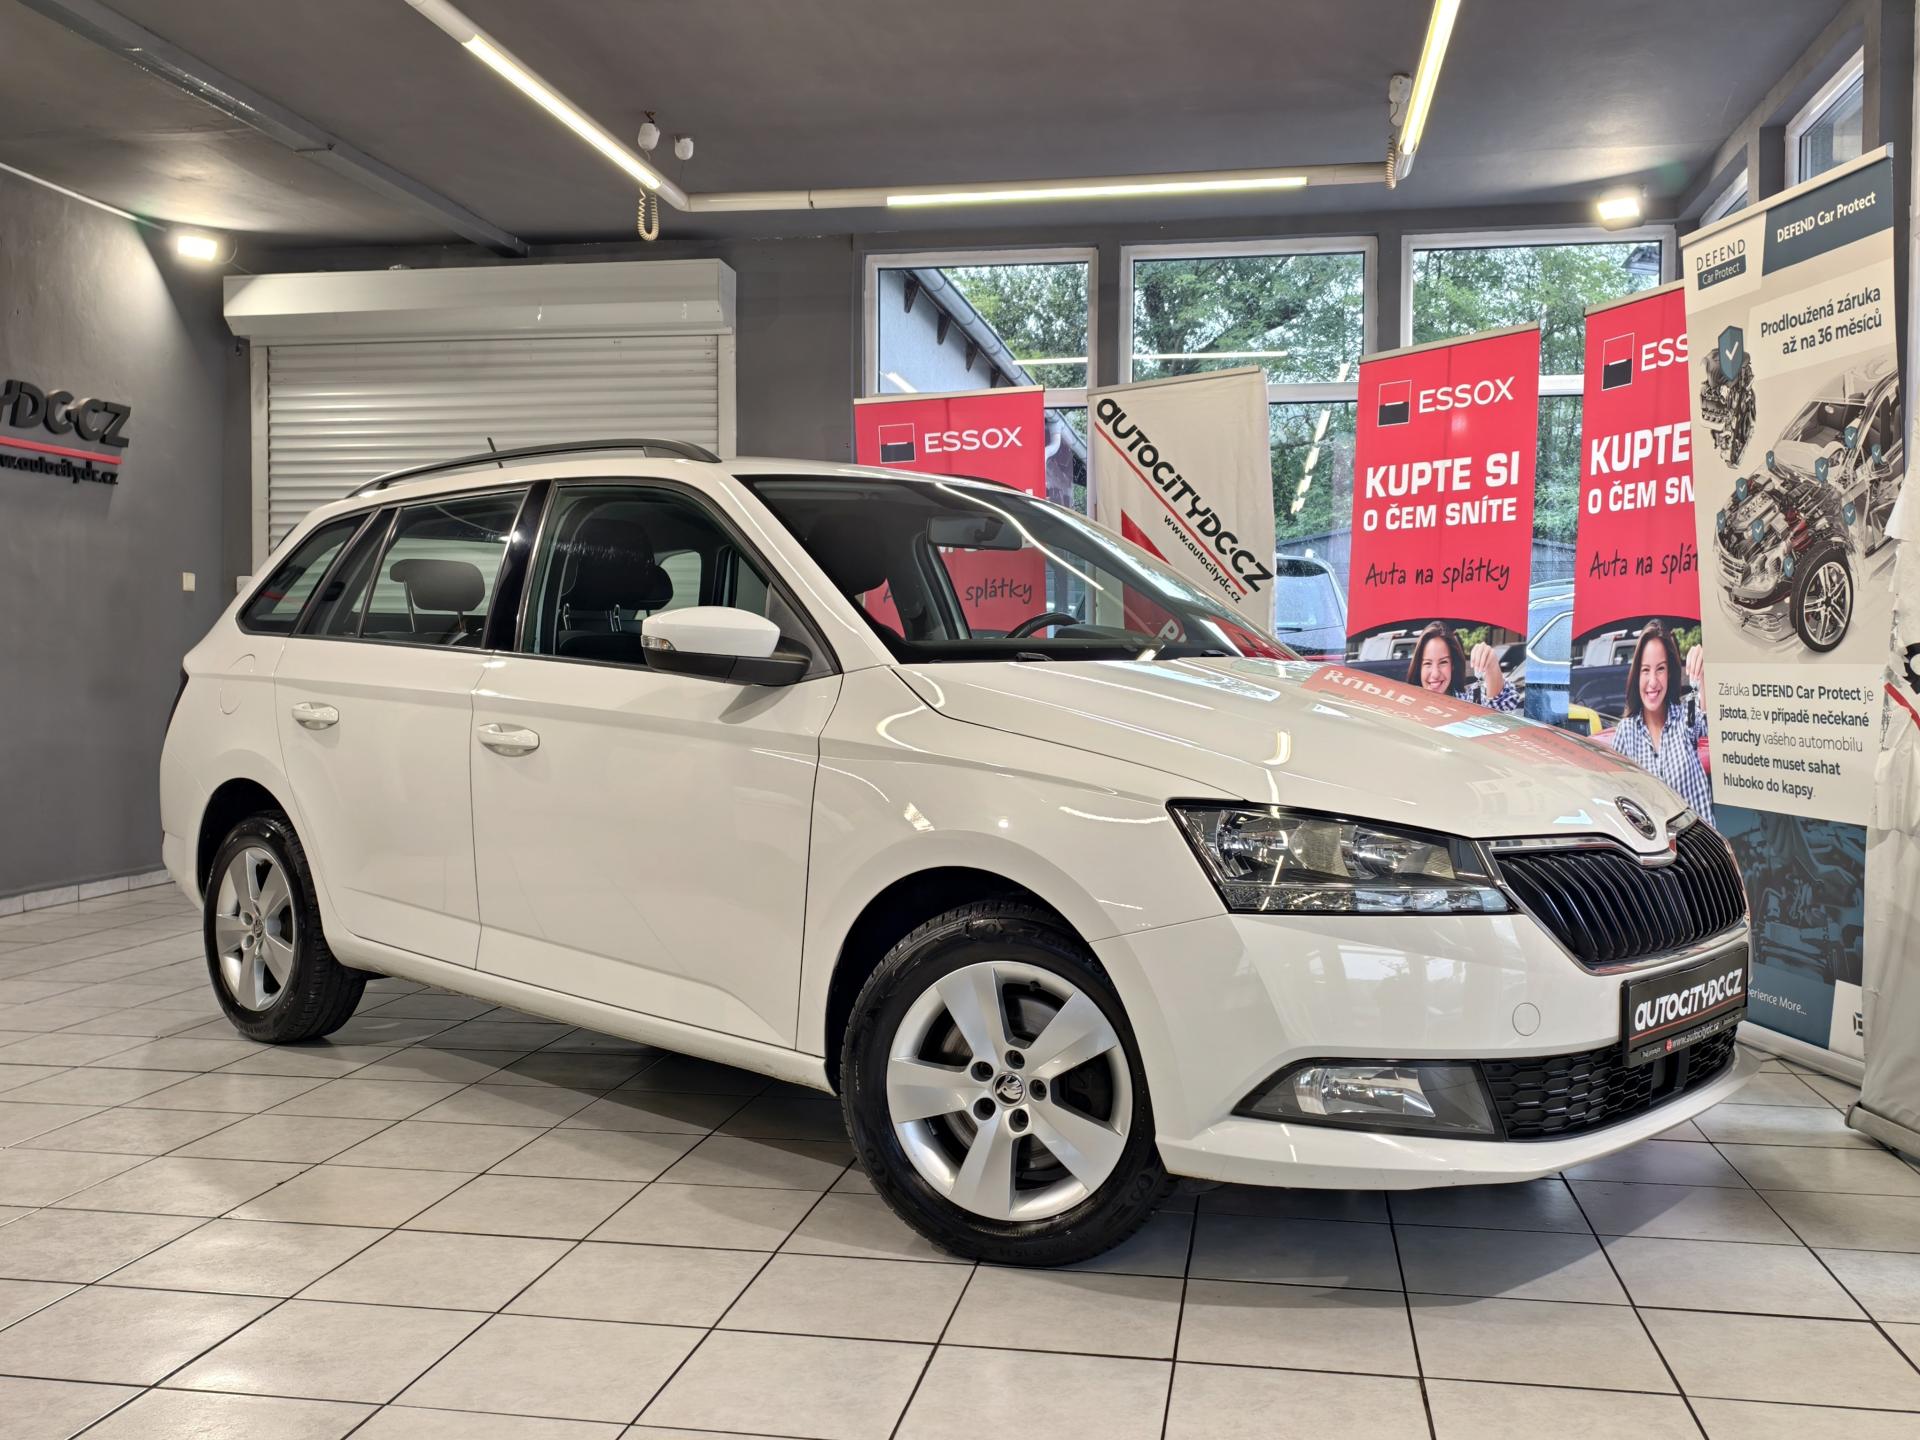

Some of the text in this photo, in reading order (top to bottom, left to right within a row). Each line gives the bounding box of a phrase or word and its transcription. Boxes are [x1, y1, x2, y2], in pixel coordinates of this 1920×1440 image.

[1777, 191, 1876, 243] DEFEND Car Protect
[1696, 239, 1745, 271] DEFEND
[1702, 262, 1740, 285] Car Protect
[1761, 287, 1881, 337] Prodloužená záruka
[1782, 308, 1883, 355] až na 36 měsíců
[1641, 333, 1688, 371] ESS
[1418, 376, 1516, 414] ESSOX
[923, 426, 1024, 454] ESSOX
[1590, 421, 1691, 476] KUPTE
[1365, 450, 1520, 499] KUPTE SI
[1587, 475, 1695, 515] O ČEM SN
[1362, 495, 1517, 532] O ČEM SNÍTE
[1164, 515, 1241, 604] www.autocitydc.cz
[1365, 558, 1511, 592] Auta na splátky
[1589, 551, 1628, 578] Auta
[1635, 555, 1653, 575] na
[965, 577, 1033, 608] splátky
[1718, 682, 1874, 704] Záruka DEFEND Car Protect je
[1719, 704, 1869, 727] jistota, že v případě nečekané
[1721, 729, 1863, 752] poruchy vašeho automobilu
[1722, 751, 1841, 775] nebudete muset sahat
[1723, 773, 1816, 799] hluboko do kapsy.
[1748, 987, 1807, 1015] erience More...
